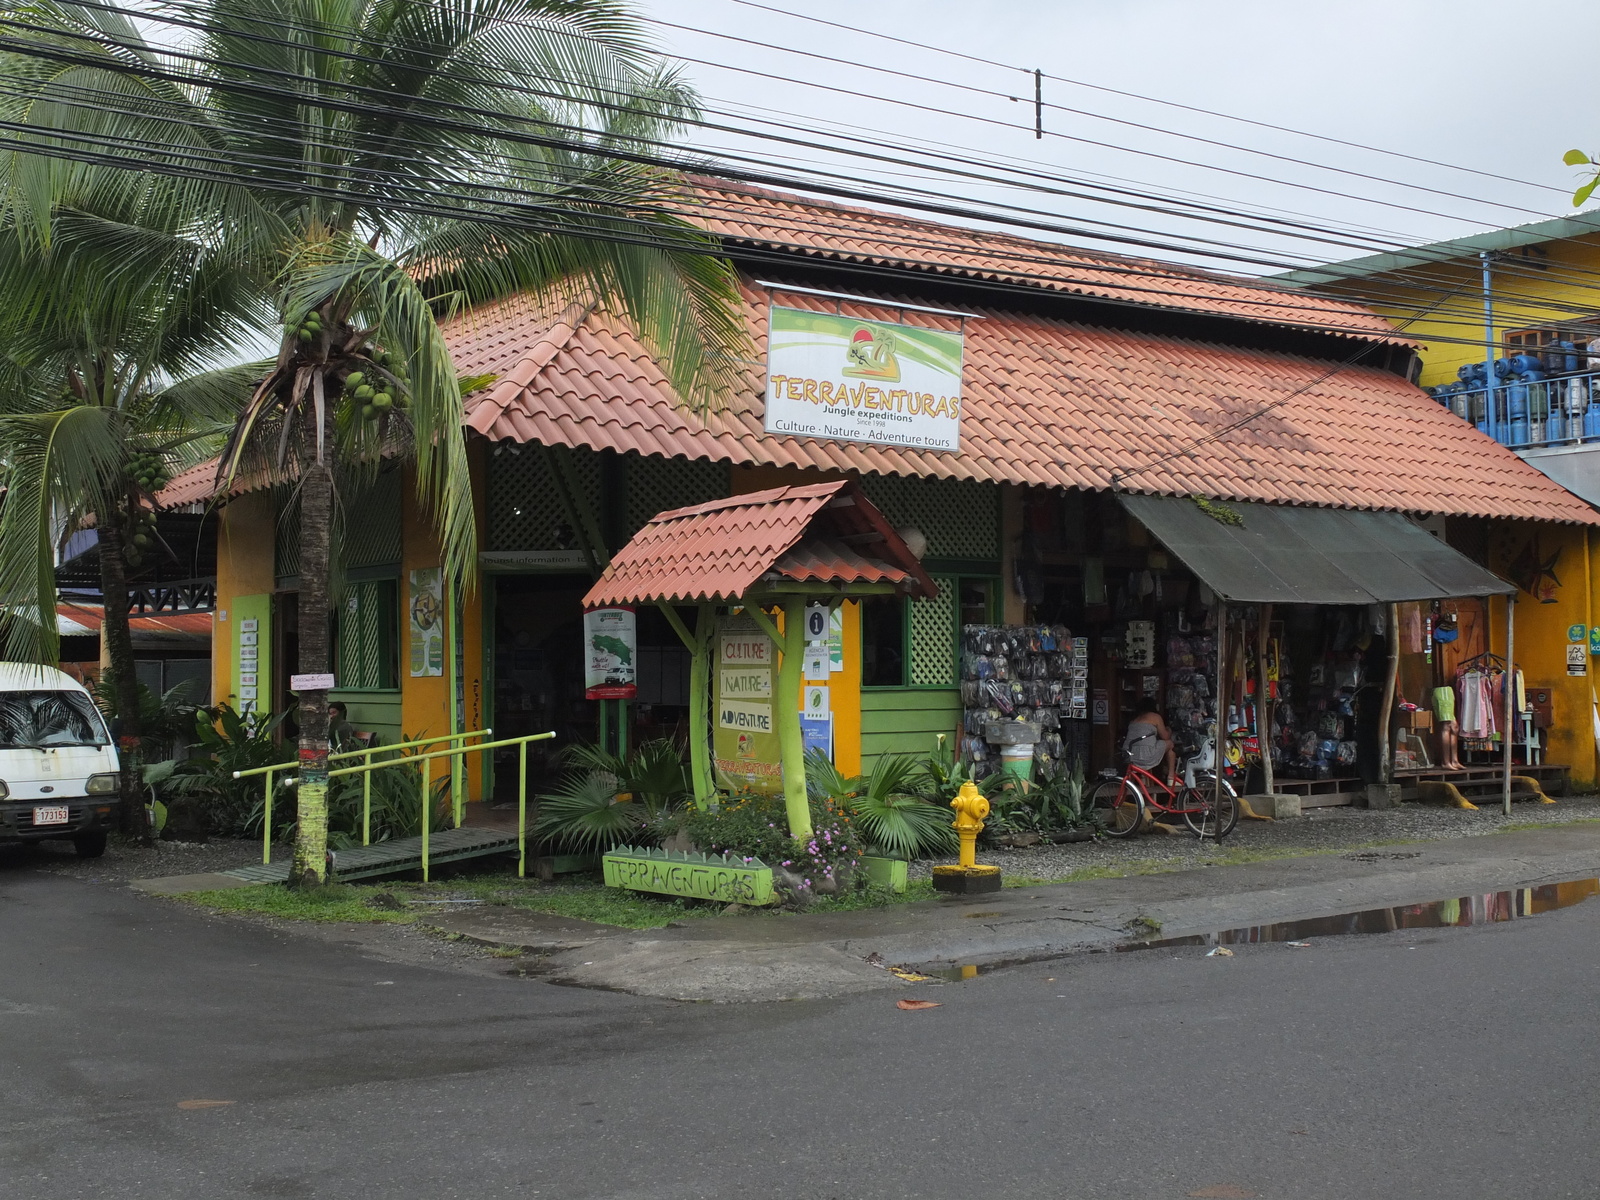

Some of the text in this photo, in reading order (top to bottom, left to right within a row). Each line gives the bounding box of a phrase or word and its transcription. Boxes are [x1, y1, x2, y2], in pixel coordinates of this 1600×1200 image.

[771, 375, 959, 420] TERRAVENTURAS
[823, 405, 913, 423] Jungle expeditions
[857, 418, 886, 427] Since 1998
[775, 419, 950, 447] Culture Nature Adventure tours
[516, 556, 571, 565] information
[725, 642, 764, 659] CULTURE
[725, 675, 762, 692] NATURE
[721, 710, 770, 730] ADVENTURE
[716, 759, 781, 776] TERRAVENTURAS
[41, 810, 67, 820] 173153
